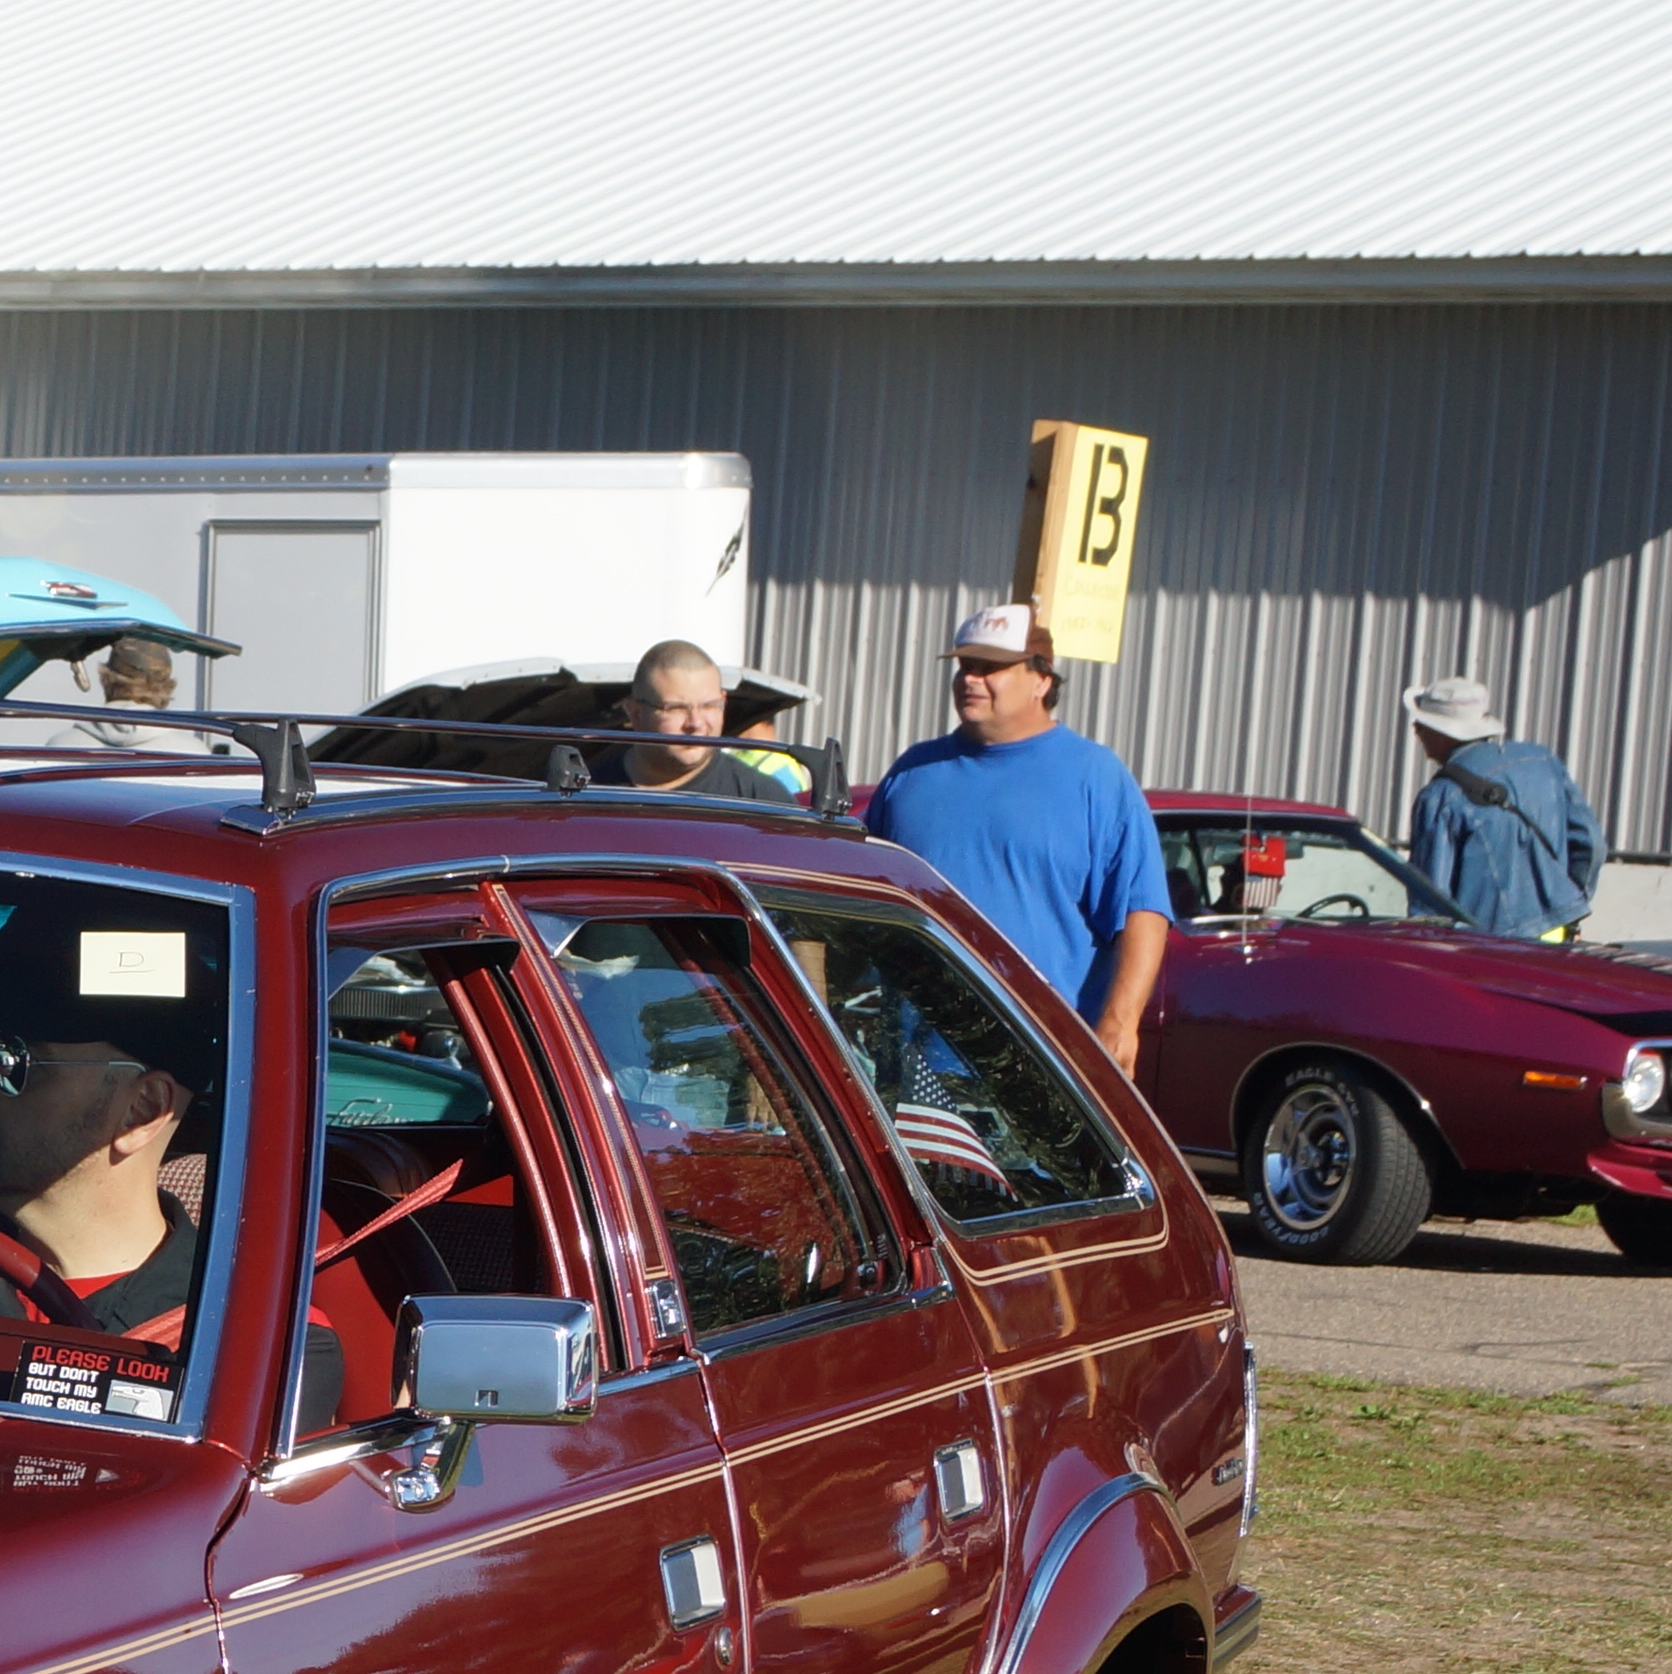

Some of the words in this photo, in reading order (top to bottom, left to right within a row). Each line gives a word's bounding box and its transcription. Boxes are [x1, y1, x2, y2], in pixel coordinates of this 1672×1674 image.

[1077, 442, 1130, 568] B
[118, 951, 145, 968] D
[1285, 1066, 1335, 1087] EAGLE
[1253, 1192, 1330, 1246] GOODYEAR
[28, 1362, 57, 1378] BUT
[31, 1345, 111, 1372] PLEASE
[116, 1357, 171, 1383] LOOK
[25, 1376, 71, 1395] TOUCH
[73, 1383, 98, 1399] MY
[21, 1392, 53, 1408] AMC
[56, 1396, 103, 1415] EAGLE
